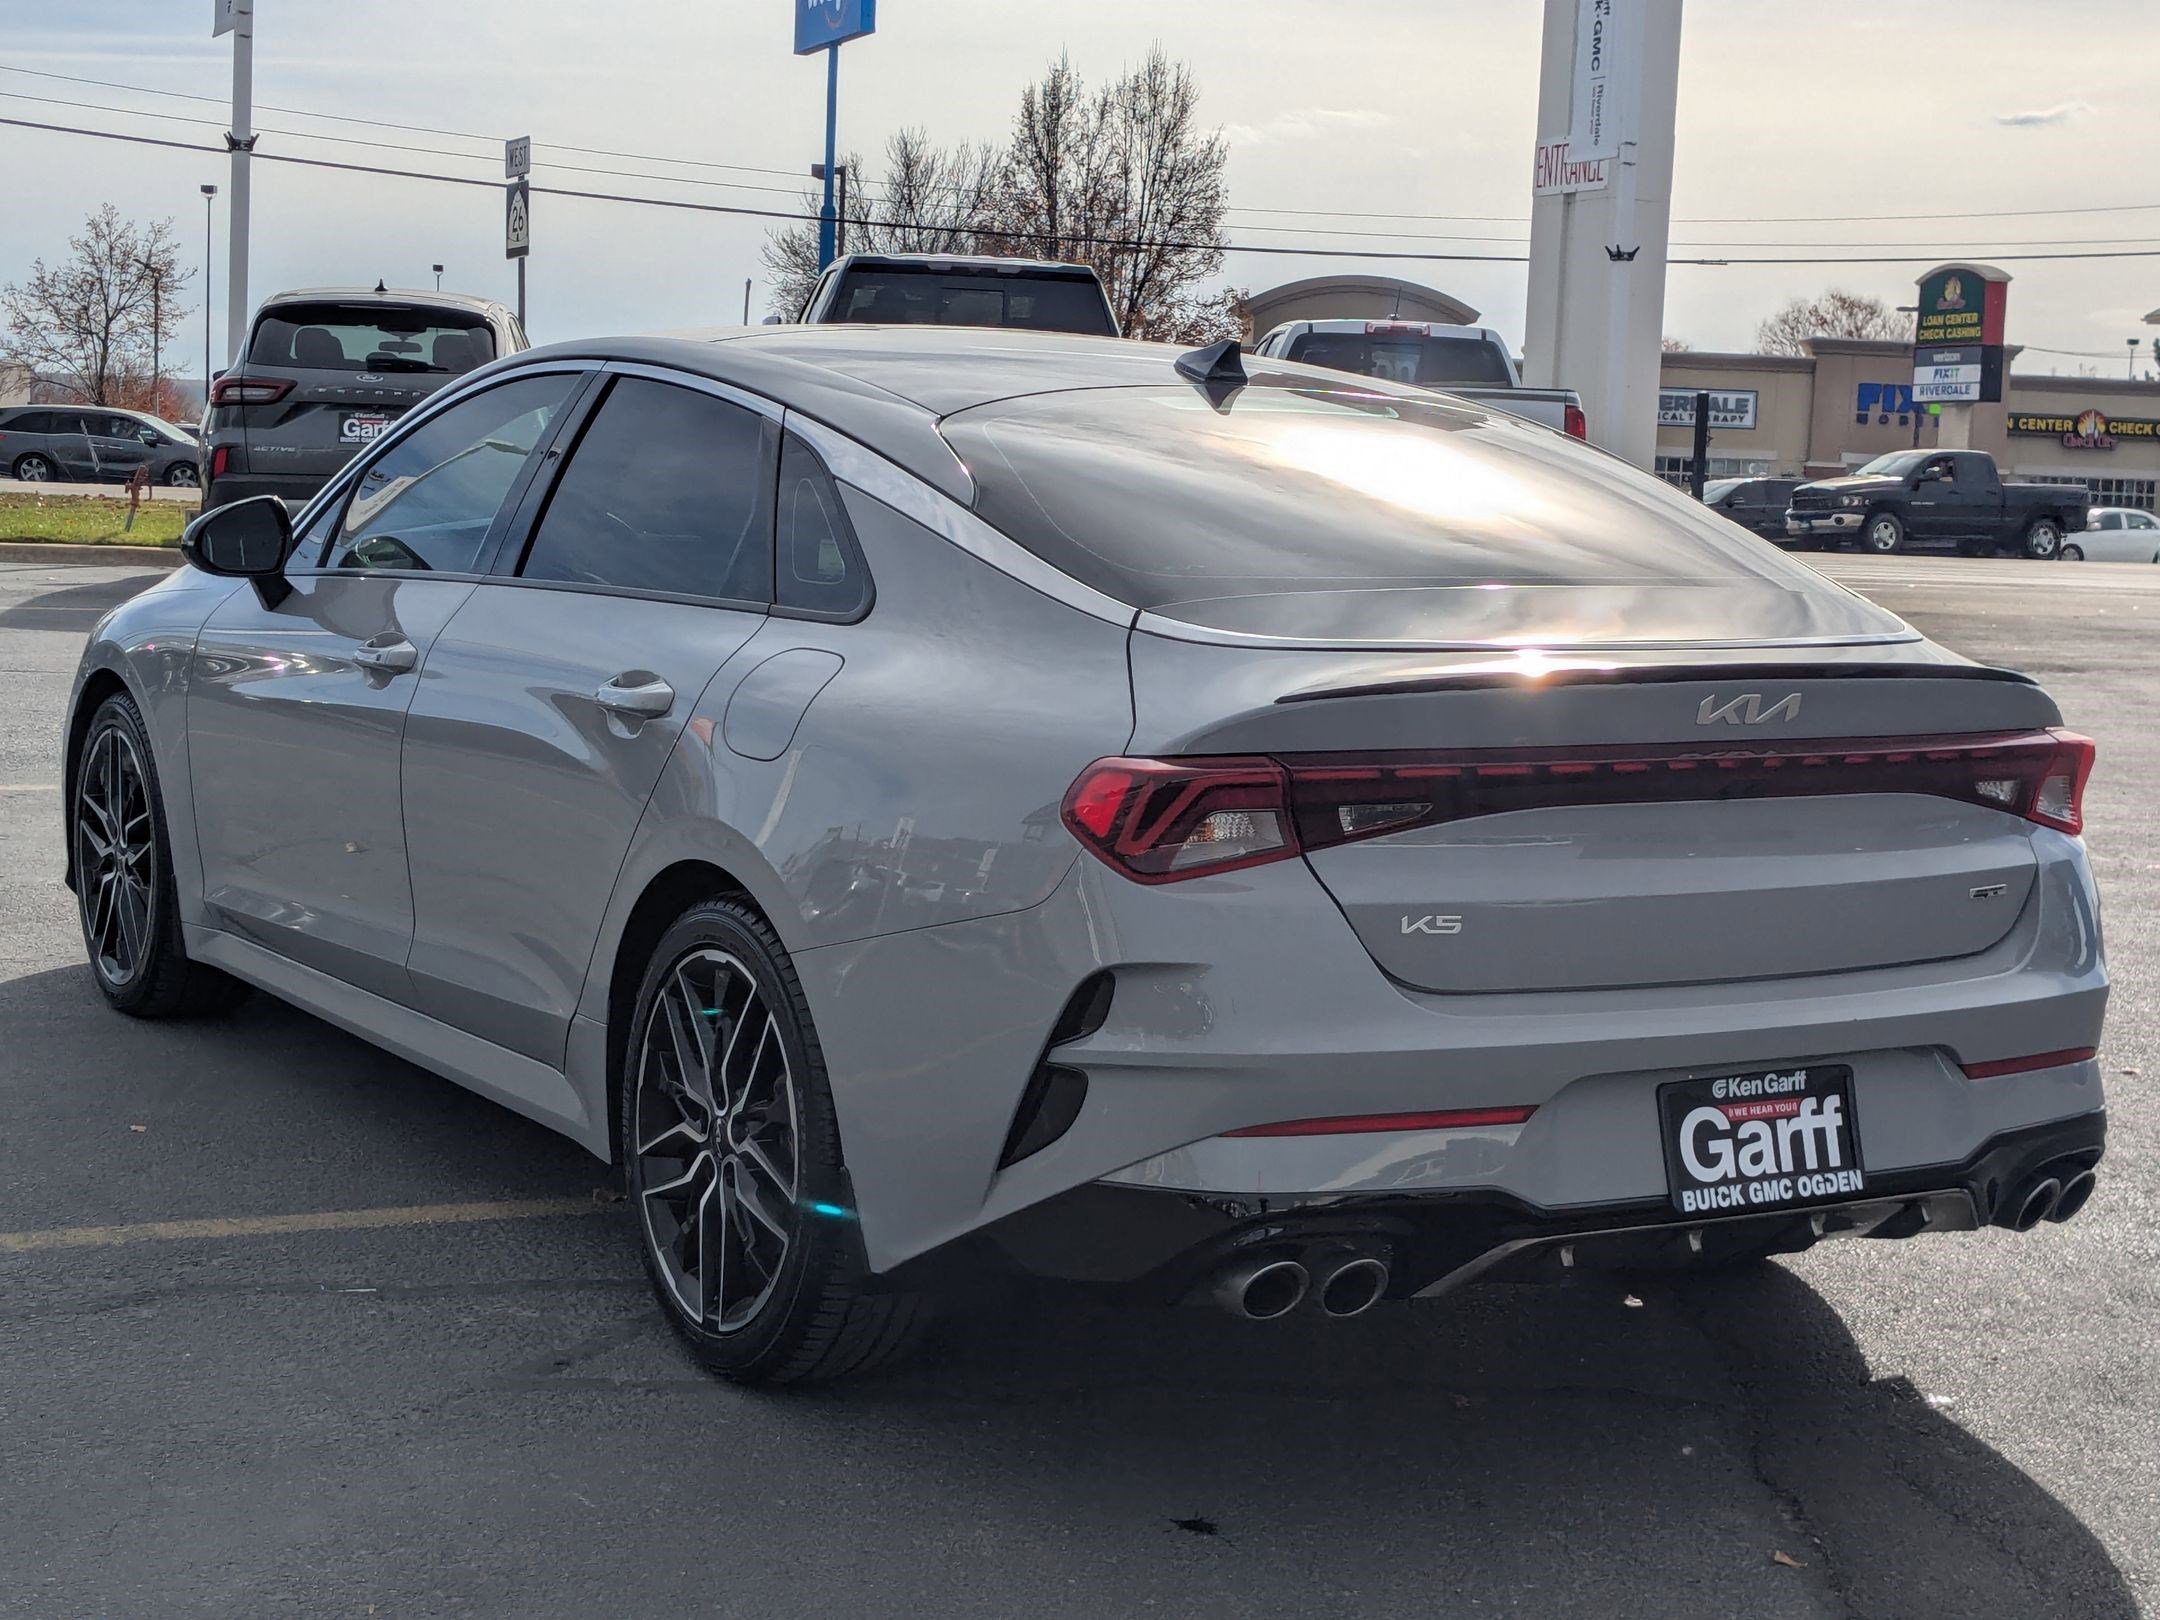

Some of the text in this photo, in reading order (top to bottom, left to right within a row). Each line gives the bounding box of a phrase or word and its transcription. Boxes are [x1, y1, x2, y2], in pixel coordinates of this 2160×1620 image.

[509, 145, 527, 169] WEST
[512, 205, 524, 233] 26
[1922, 312, 1978, 326] LOAN CENTER
[1919, 326, 1982, 340] CHECK CASHING
[1919, 384, 1971, 396] RIVERDALE
[2018, 418, 2073, 432] CENTER
[2109, 421, 2153, 435] CHECK
[1695, 692, 1802, 725] KIA
[1400, 915, 1463, 934] K5
[1728, 1070, 1807, 1098] Ken Garff
[1734, 1102, 1793, 1117] WE HEAR YOU
[1680, 1094, 1843, 1183] Garff
[1682, 1169, 1864, 1212] BUICK GMC OGDEN
